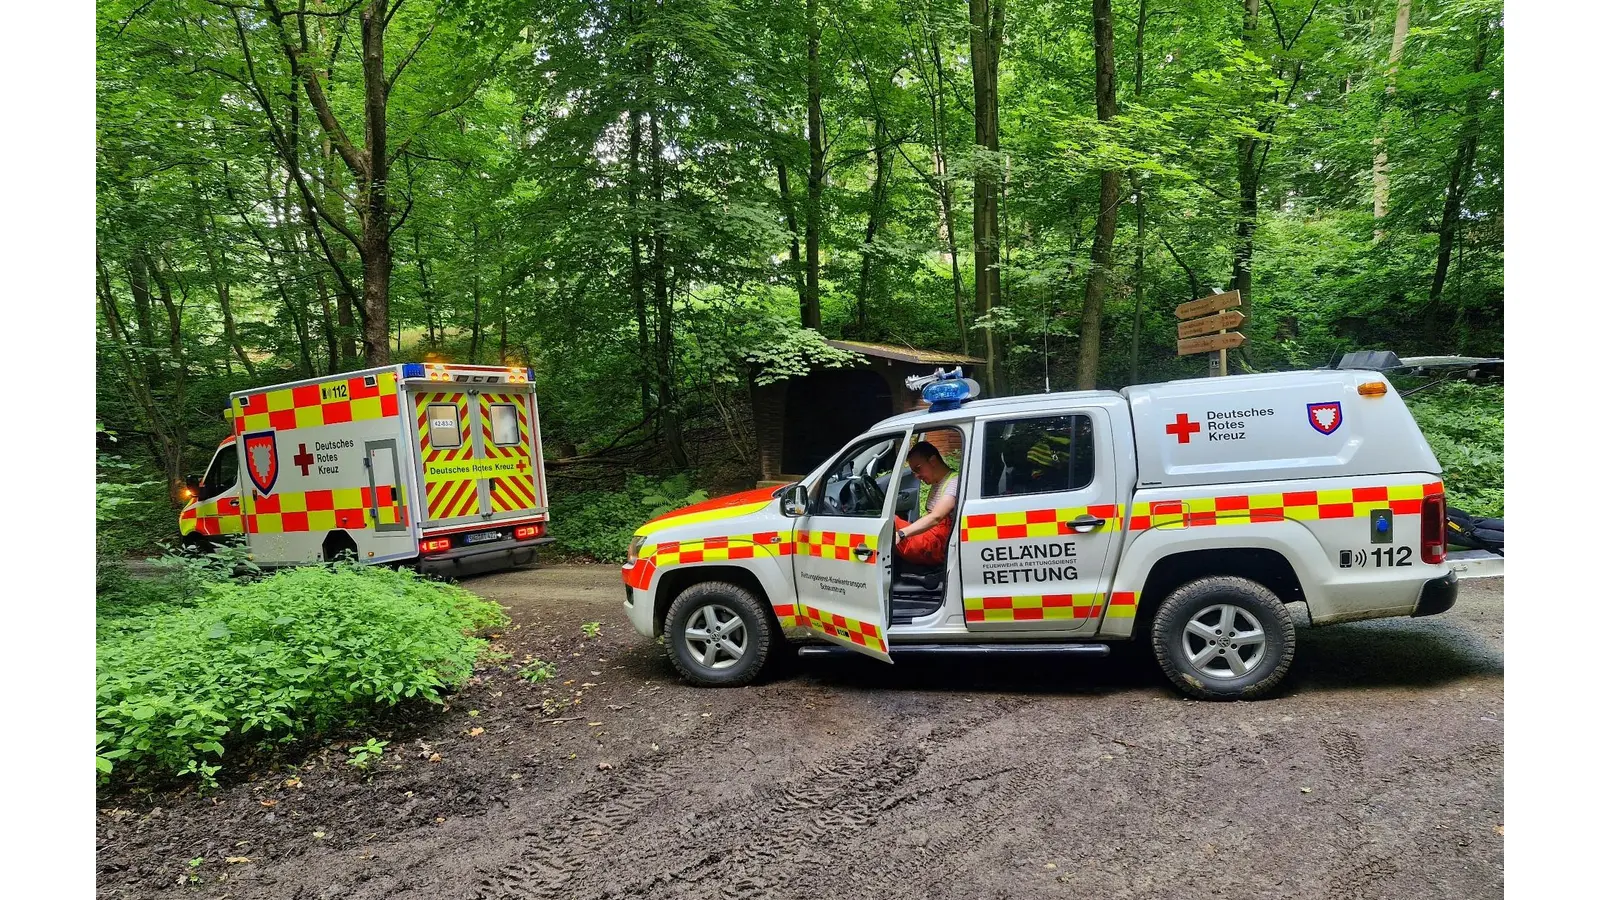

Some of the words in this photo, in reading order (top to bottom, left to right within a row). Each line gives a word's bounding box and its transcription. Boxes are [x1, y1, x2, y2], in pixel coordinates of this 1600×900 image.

[332, 384, 347, 398] 112
[1206, 407, 1275, 420] Deutsches
[1208, 420, 1245, 431] Rotes
[1208, 431, 1246, 441] Kreuz
[315, 439, 354, 451] Deutsches
[317, 453, 338, 463] Rotes
[318, 465, 339, 475] Kreuz
[430, 466, 470, 475] Deutsches
[472, 464, 493, 473] Rotes
[494, 463, 514, 471] Kreuz
[980, 542, 1077, 562] GELÄNDE
[1371, 546, 1413, 567] 112
[1024, 558, 1077, 567] RETTUNGSDIENST
[982, 566, 1078, 584] RETTUNG
